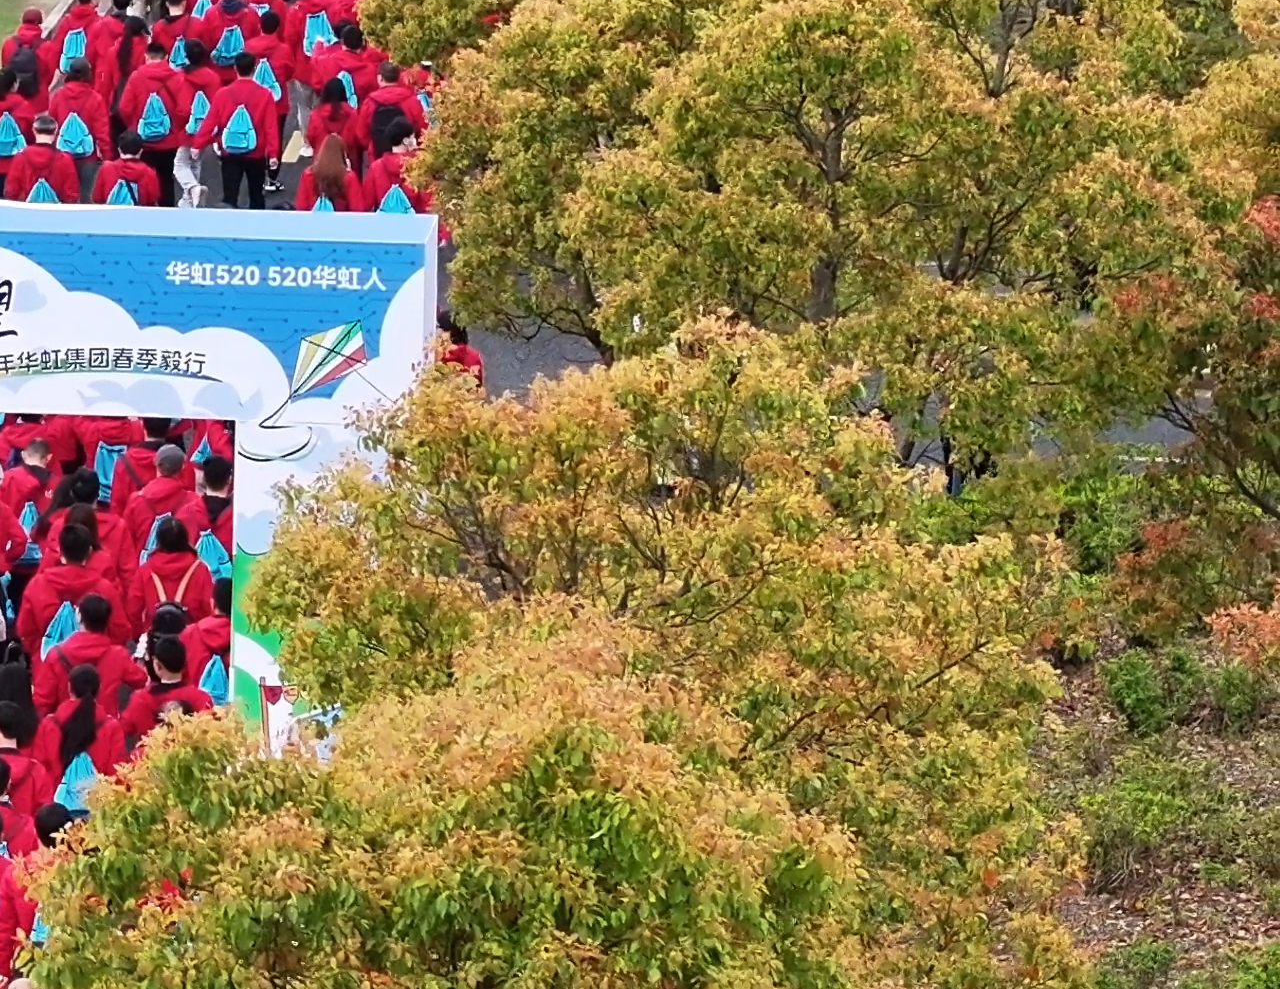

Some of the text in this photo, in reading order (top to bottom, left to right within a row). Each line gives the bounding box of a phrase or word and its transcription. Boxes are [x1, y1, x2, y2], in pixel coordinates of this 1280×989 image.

[165, 260, 387, 293] 华虹520 520华虹人
